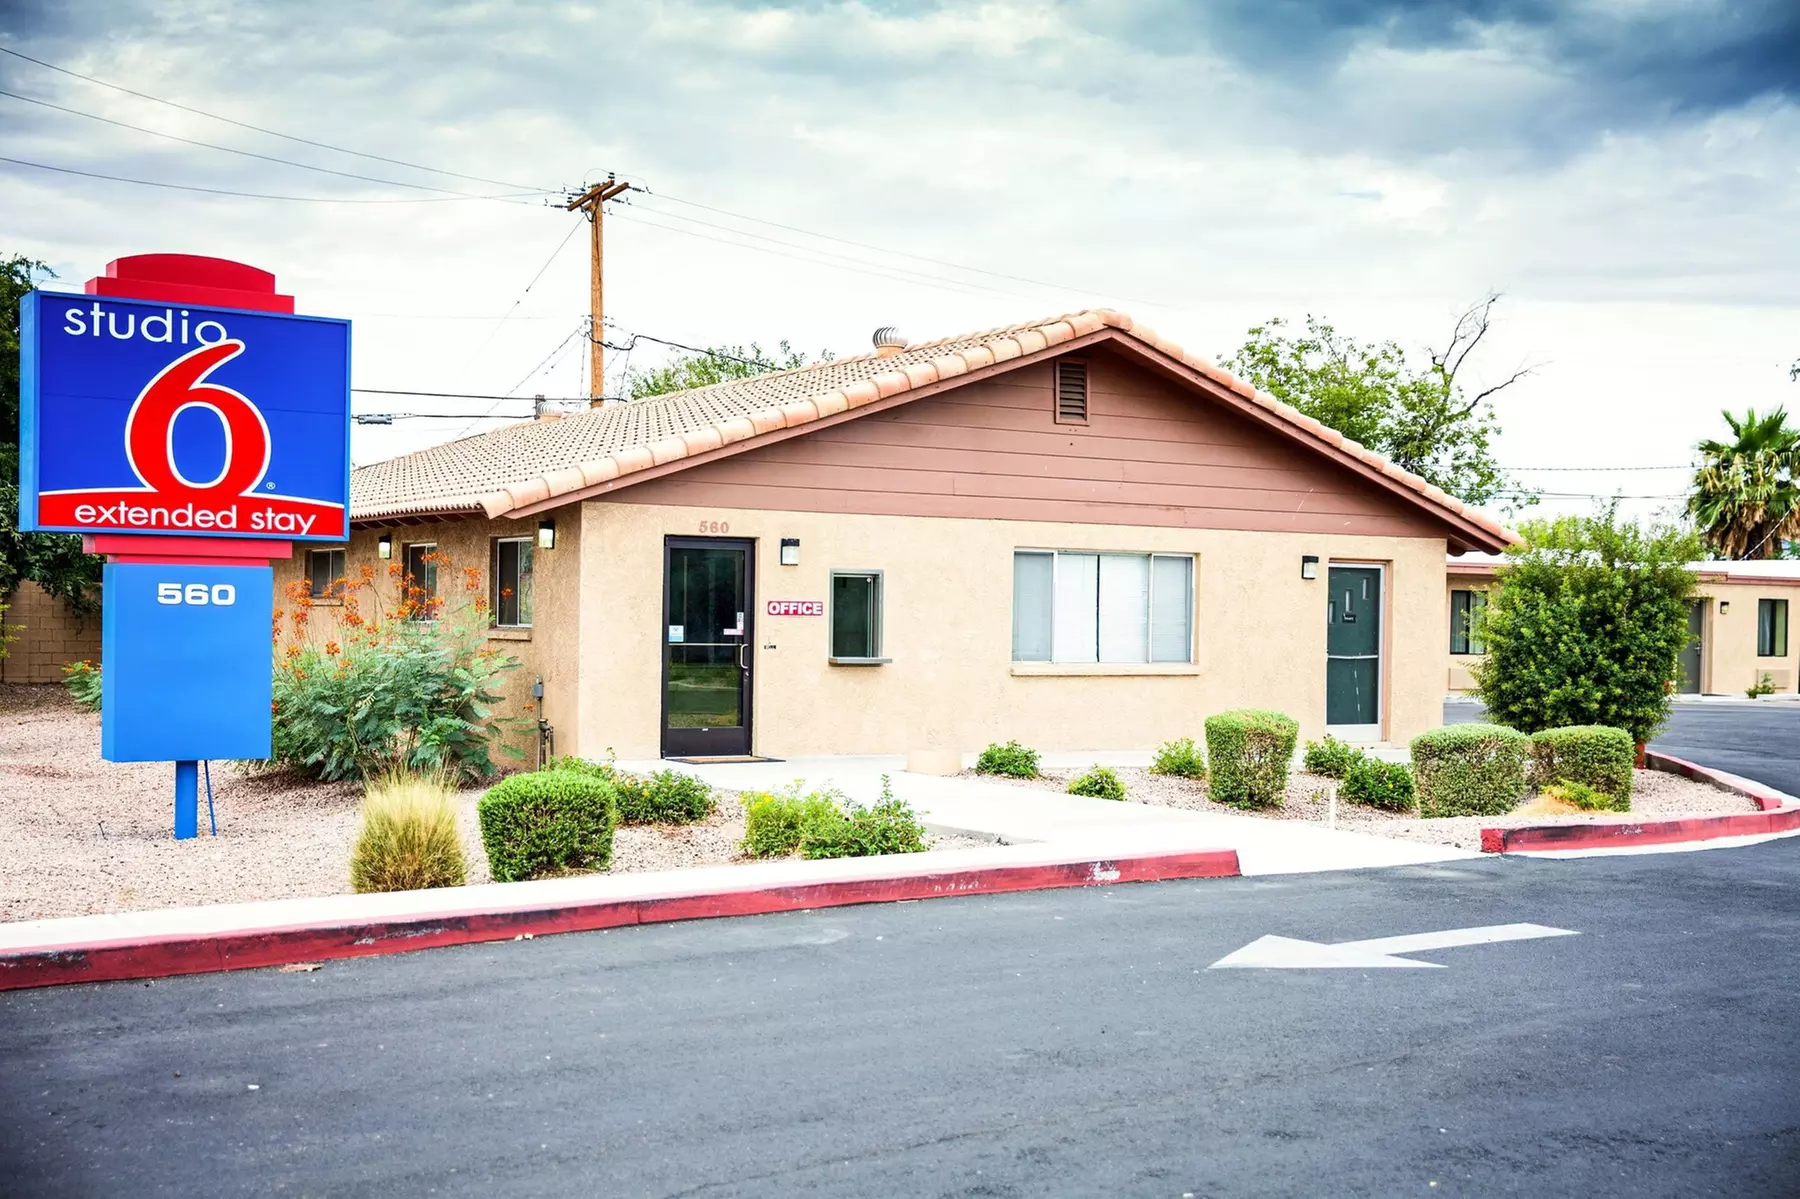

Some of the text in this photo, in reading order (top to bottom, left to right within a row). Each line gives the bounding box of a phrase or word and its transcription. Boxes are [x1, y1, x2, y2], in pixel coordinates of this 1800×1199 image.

[64, 302, 227, 346] studio
[126, 339, 271, 497] 6
[75, 503, 317, 535] extended stay
[699, 521, 729, 534] 560
[157, 583, 236, 606] 560
[768, 602, 822, 615] OFFICE
